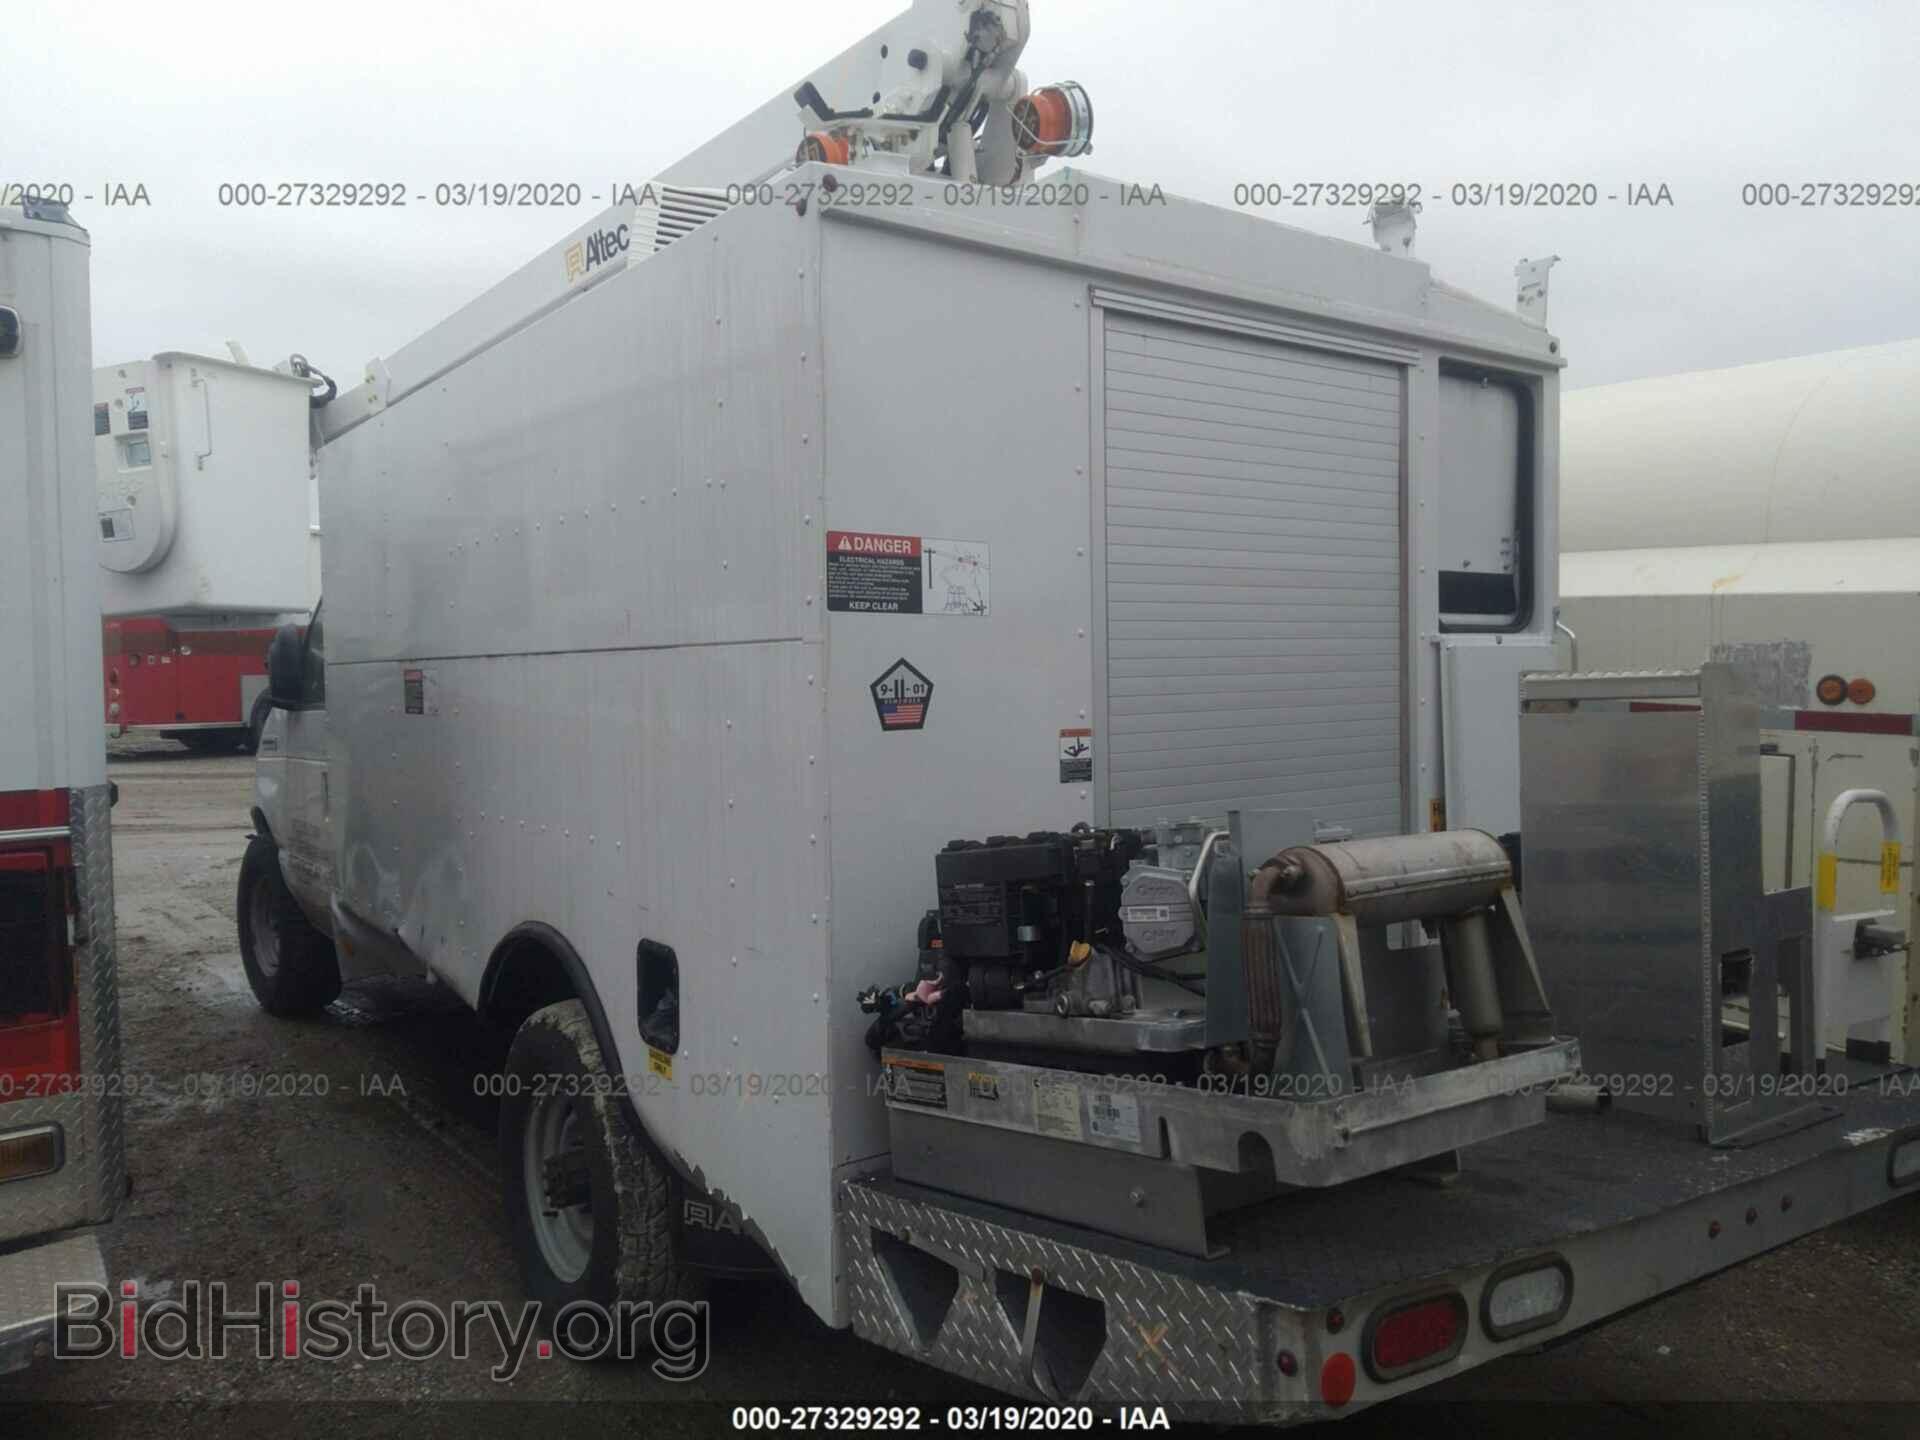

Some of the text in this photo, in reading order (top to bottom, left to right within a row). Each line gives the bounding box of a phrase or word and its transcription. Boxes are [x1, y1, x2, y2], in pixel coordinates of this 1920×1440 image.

[586, 223, 631, 272] Altec
[853, 536, 913, 554] DANGER
[848, 600, 899, 611] KEEP CLEAR
